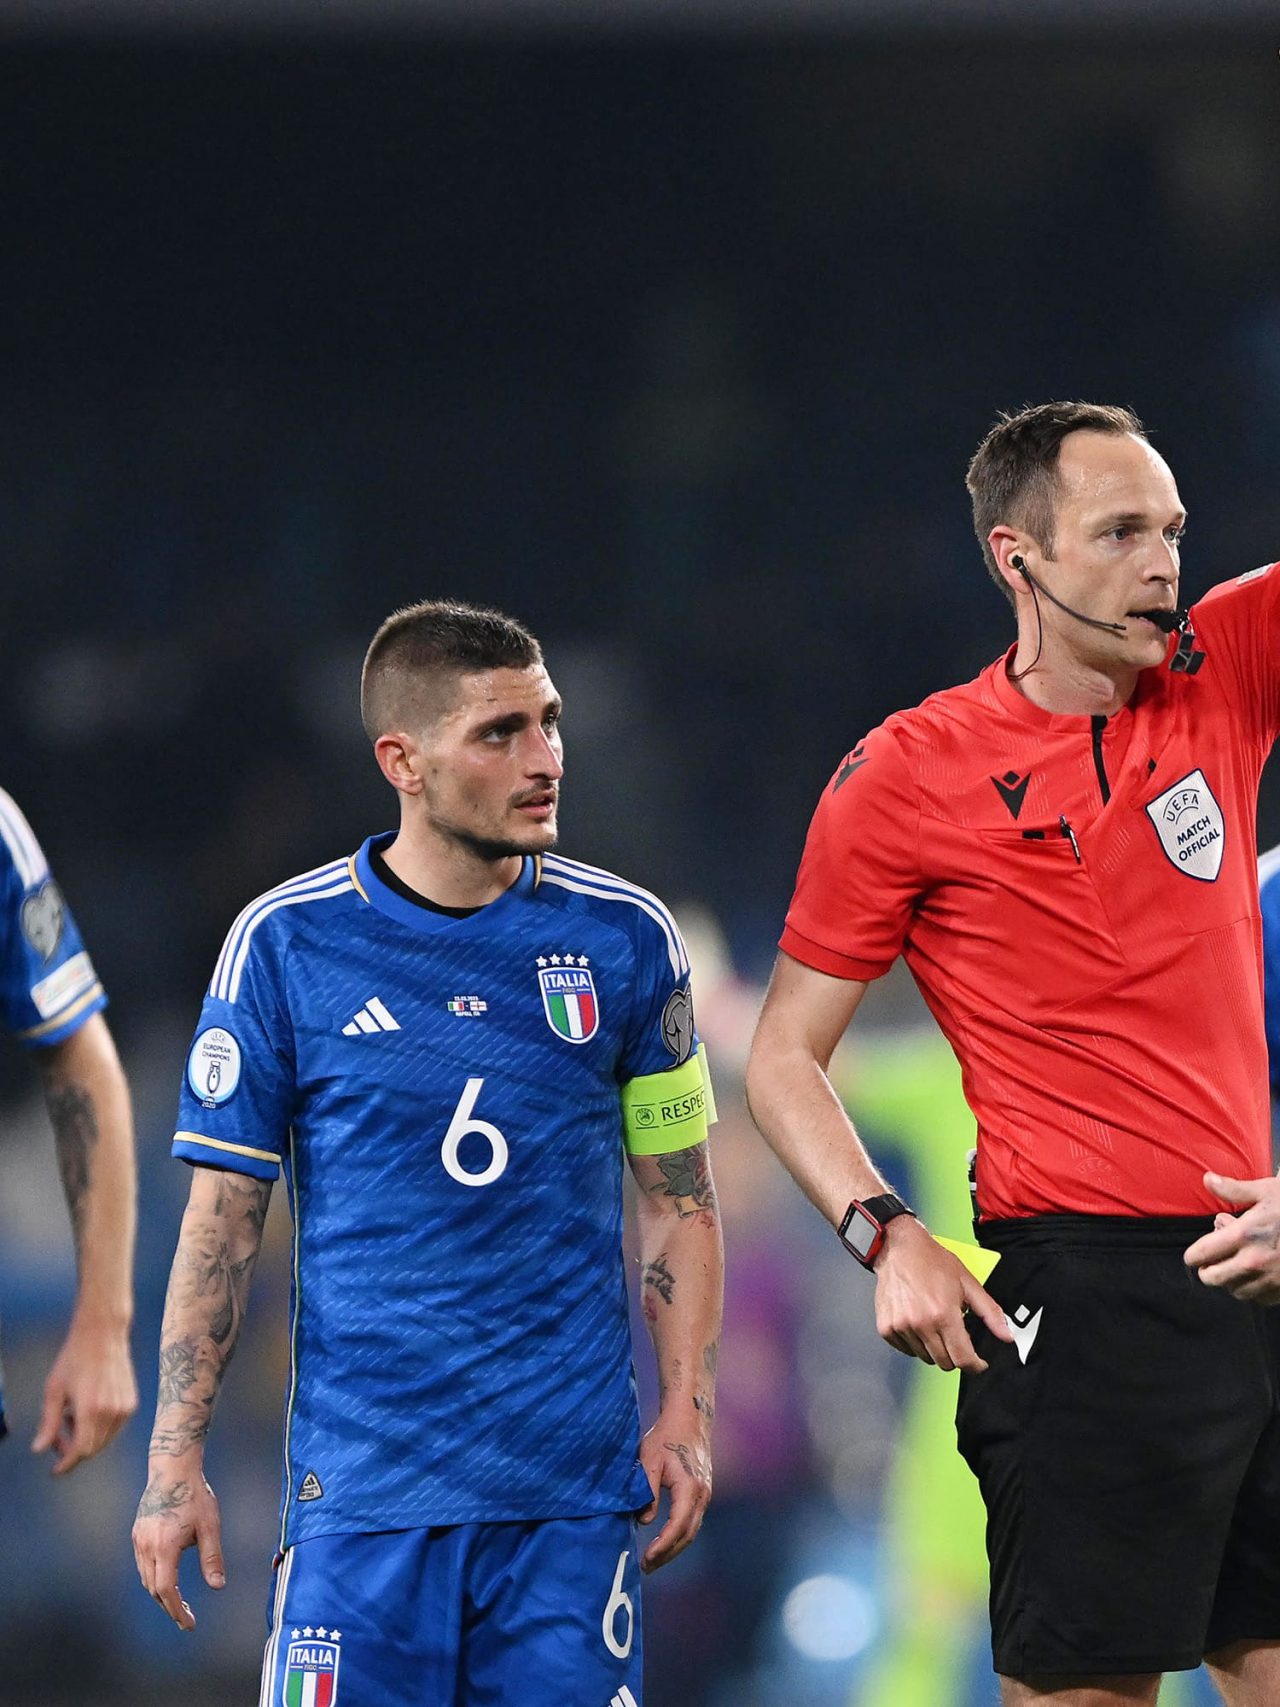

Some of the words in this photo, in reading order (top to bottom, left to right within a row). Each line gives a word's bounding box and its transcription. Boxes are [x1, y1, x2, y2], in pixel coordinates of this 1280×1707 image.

[1166, 793, 1199, 822] UEFA
[1177, 815, 1211, 846] MATCH
[1178, 828, 1221, 862] OFFICIAL
[543, 973, 590, 989] ITALIA
[202, 1050, 231, 1063] CHAMPIONS
[203, 1043, 231, 1055] EUROPEAN
[441, 1078, 509, 1187] 6
[602, 1551, 634, 1659] 6
[291, 1648, 334, 1665] ITALIA
